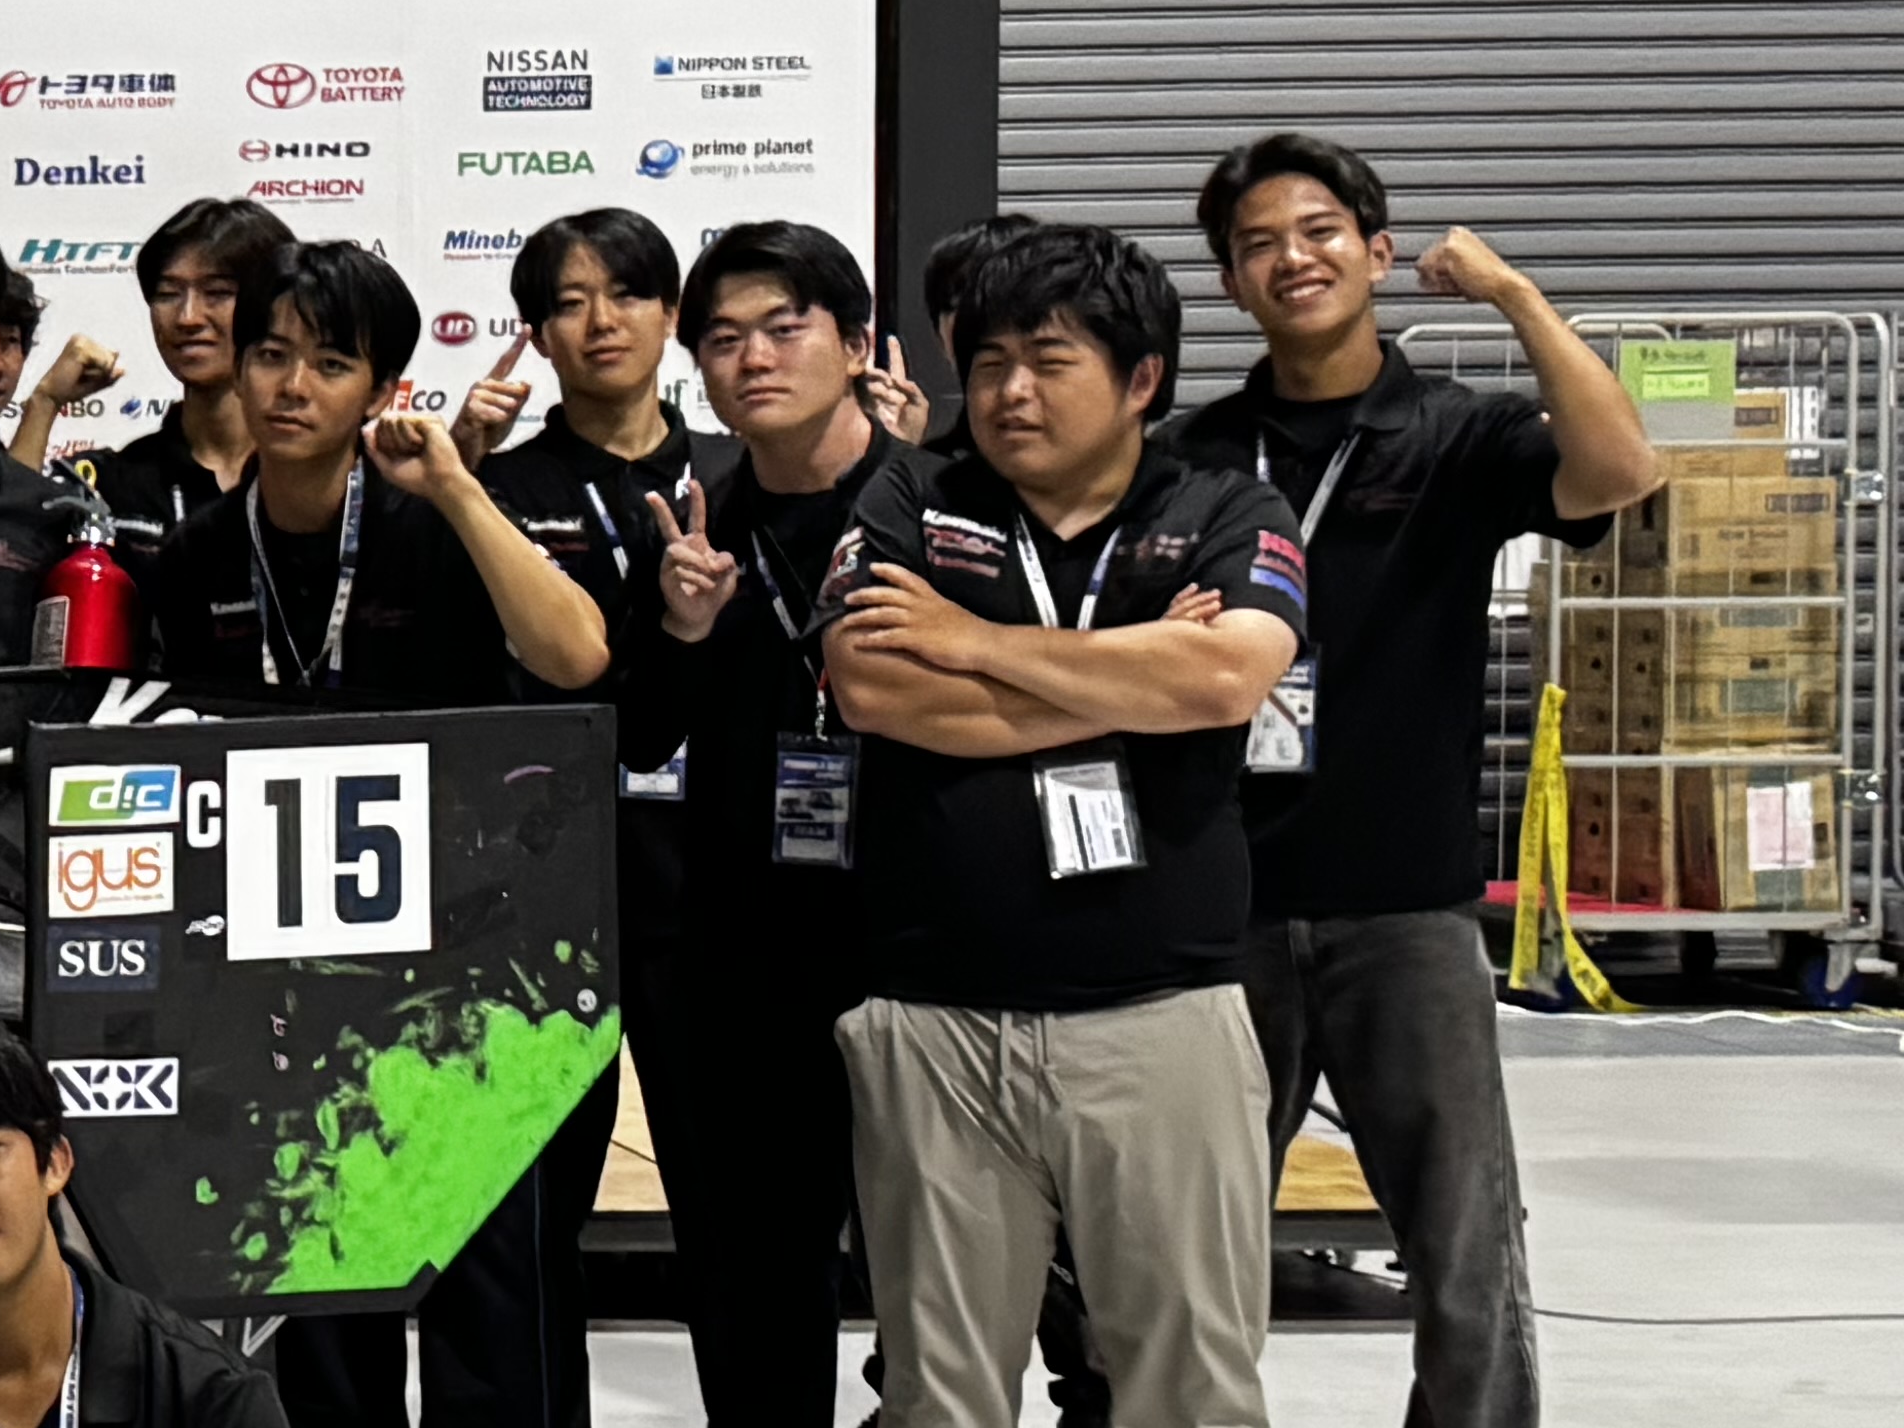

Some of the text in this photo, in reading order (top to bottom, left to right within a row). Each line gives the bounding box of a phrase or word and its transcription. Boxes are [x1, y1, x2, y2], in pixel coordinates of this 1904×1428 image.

[487, 49, 589, 73] NISSAN
[678, 56, 809, 71] NIPPON STEEL
[38, 73, 176, 95] トヨタ車体
[323, 68, 403, 83] TOYOTA
[487, 78, 589, 94] AUTOMOTIVE
[321, 86, 405, 103] BATTERY
[487, 94, 589, 109] TECHNOLOGY
[275, 142, 371, 158] HINO
[692, 138, 814, 159] prime planet
[14, 155, 146, 186] Denkei
[457, 151, 595, 176] FUTABA
[246, 178, 364, 197] ARCHION
[187, 780, 221, 848] C
[265, 775, 402, 928] 15
[57, 842, 162, 912] igus
[58, 939, 146, 977] SUS
